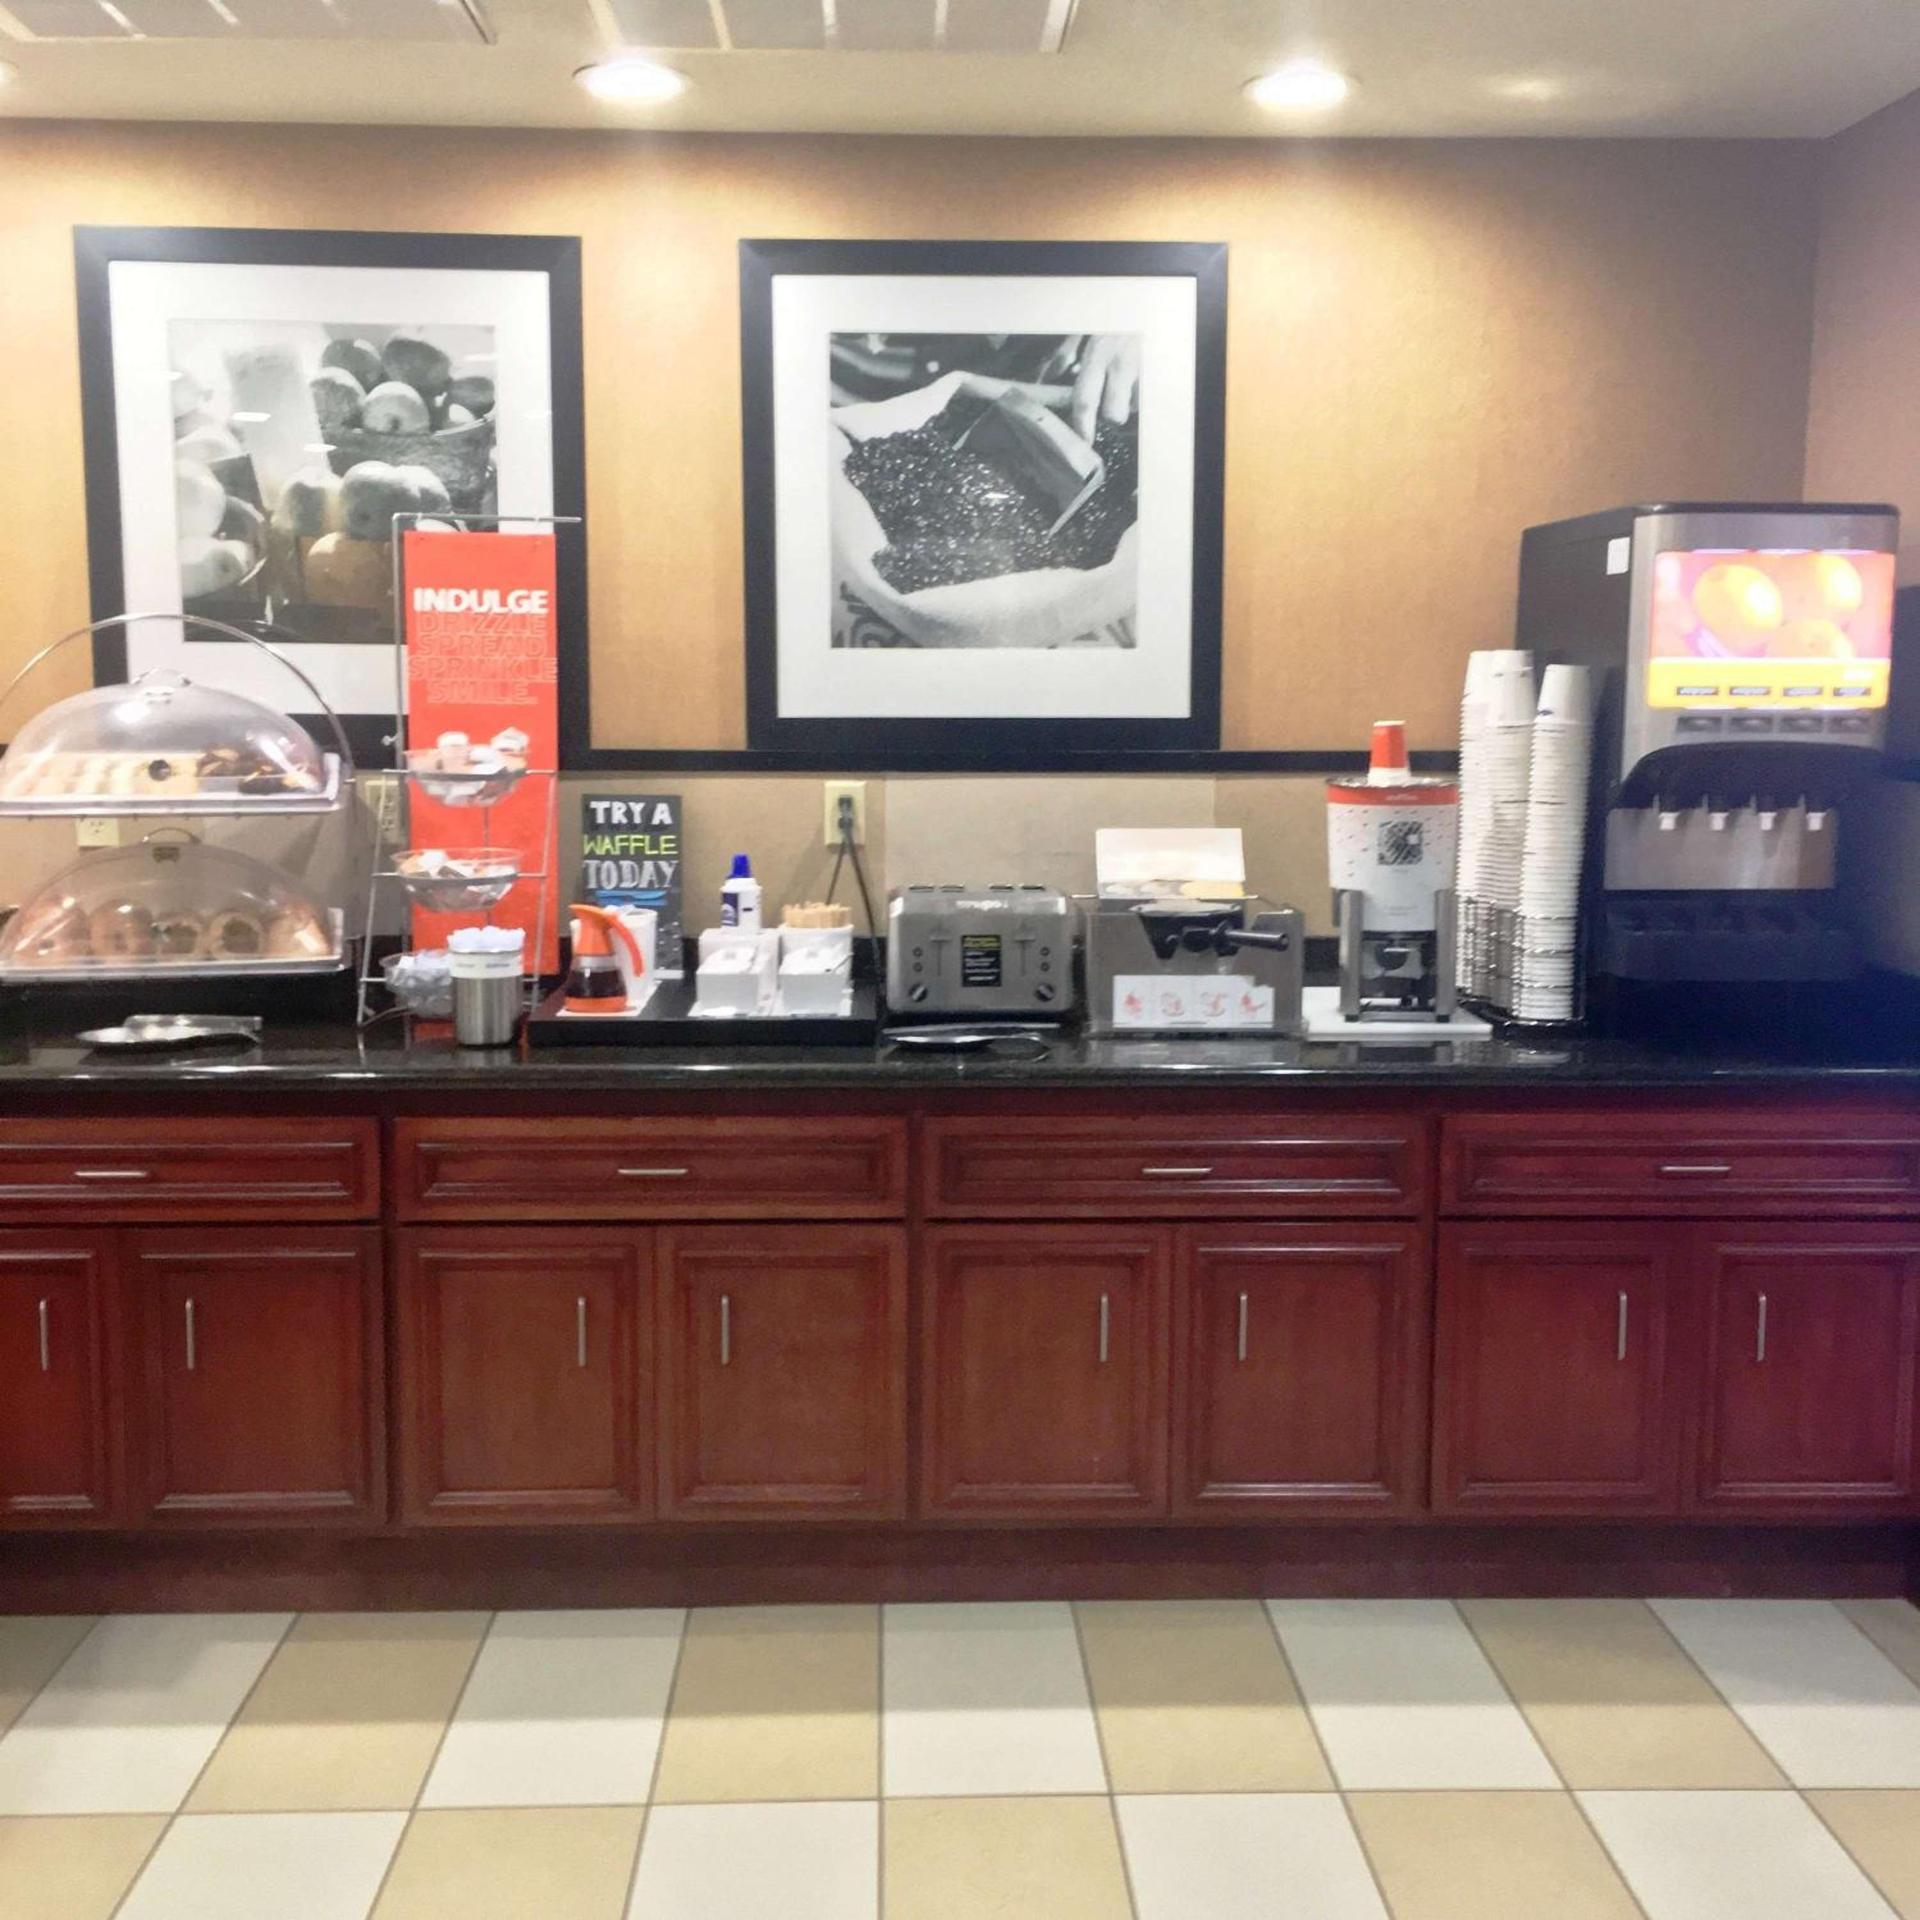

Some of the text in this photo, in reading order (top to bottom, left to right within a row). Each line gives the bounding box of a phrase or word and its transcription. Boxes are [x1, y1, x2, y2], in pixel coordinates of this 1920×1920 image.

[413, 587, 549, 614] INDULGE
[418, 613, 548, 634] DRIZZLE
[418, 635, 547, 658] SPREAD
[409, 657, 558, 681] SPRINKLE
[589, 801, 673, 825] TRY A
[583, 834, 678, 856] WAFFLE
[582, 860, 679, 890] TODAY
